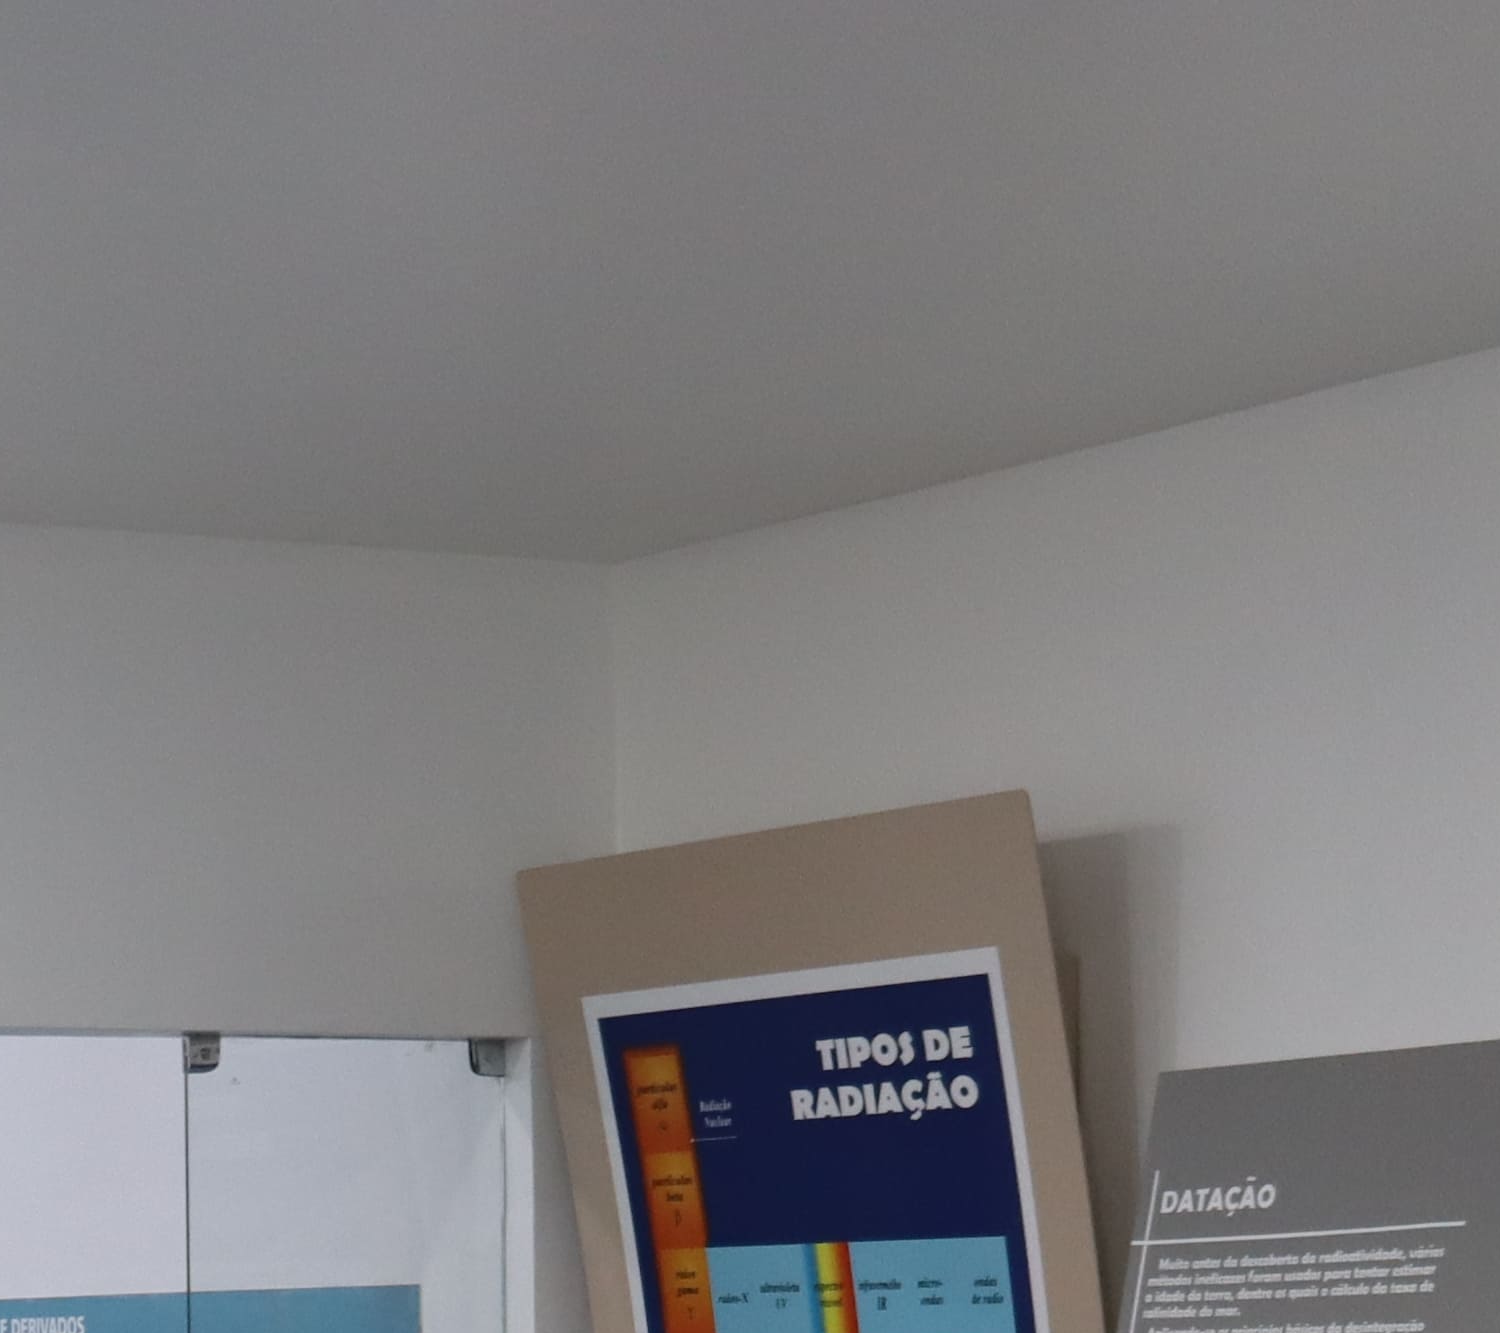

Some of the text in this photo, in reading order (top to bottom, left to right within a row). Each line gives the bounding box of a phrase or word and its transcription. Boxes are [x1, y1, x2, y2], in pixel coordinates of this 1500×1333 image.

[815, 1025, 973, 1071] TIPOS DE
[789, 1071, 979, 1121] RADIAÇÃO
[1159, 1176, 1276, 1217] DATAÇÃO
